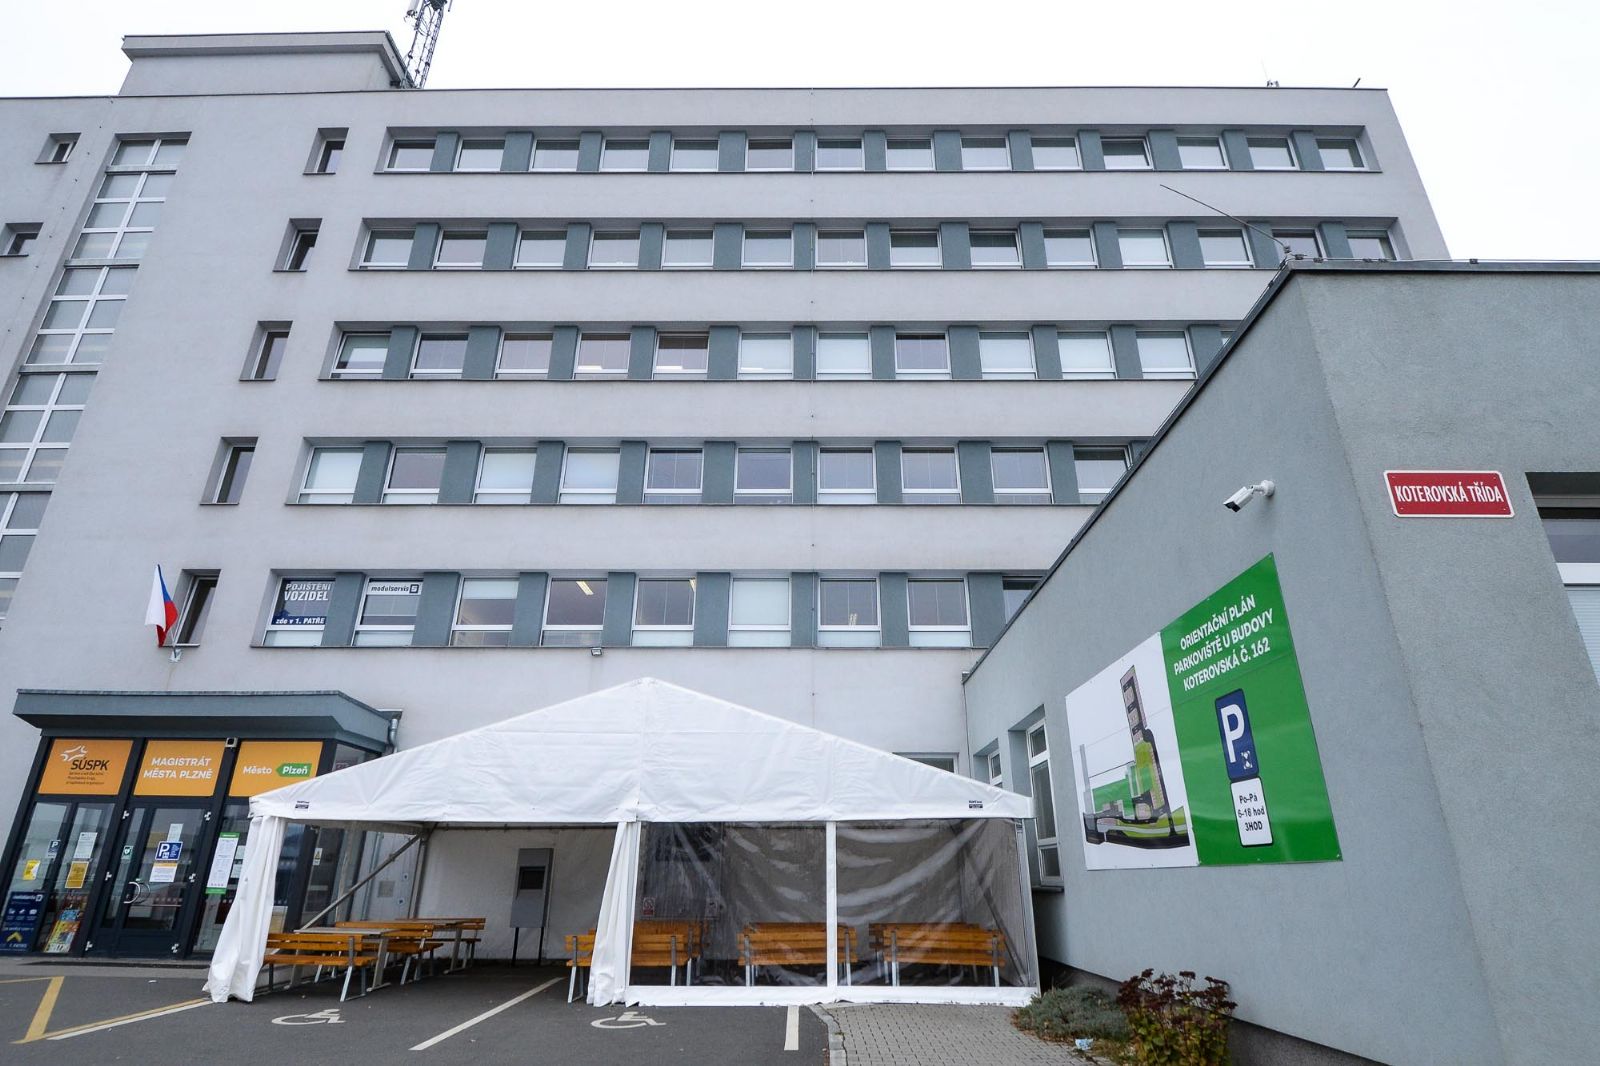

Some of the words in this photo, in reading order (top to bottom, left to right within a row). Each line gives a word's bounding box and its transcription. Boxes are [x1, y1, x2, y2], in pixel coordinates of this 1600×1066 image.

[1394, 481, 1469, 503] KOTEROVSKÁ
[1467, 481, 1504, 503] TŘÍDA
[284, 590, 329, 601] VOZIDEL
[303, 616, 326, 624] PATŘE
[1180, 606, 1229, 650] ORIENTAČNÍ
[1229, 594, 1256, 621] PLÁN
[1174, 635, 1223, 676] PARKOVIŠTĚ
[1222, 633, 1231, 648] U
[1231, 608, 1273, 644] BUDOVY
[1183, 649, 1240, 691] KOTEROVSKÁ
[1240, 644, 1251, 663] Č.
[1251, 637, 1271, 658] 162
[1220, 703, 1245, 763] P
[70, 757, 110, 771] SÚSPK
[151, 755, 212, 766] MAGISTRÁT
[143, 767, 177, 779] MĚSTA
[179, 767, 214, 779] PLZNĚ
[242, 764, 272, 775] Město
[282, 764, 309, 775] Plzeň
[1252, 806, 1265, 816] hod
[1244, 821, 1263, 831] 3HOD
[158, 843, 170, 857] P
